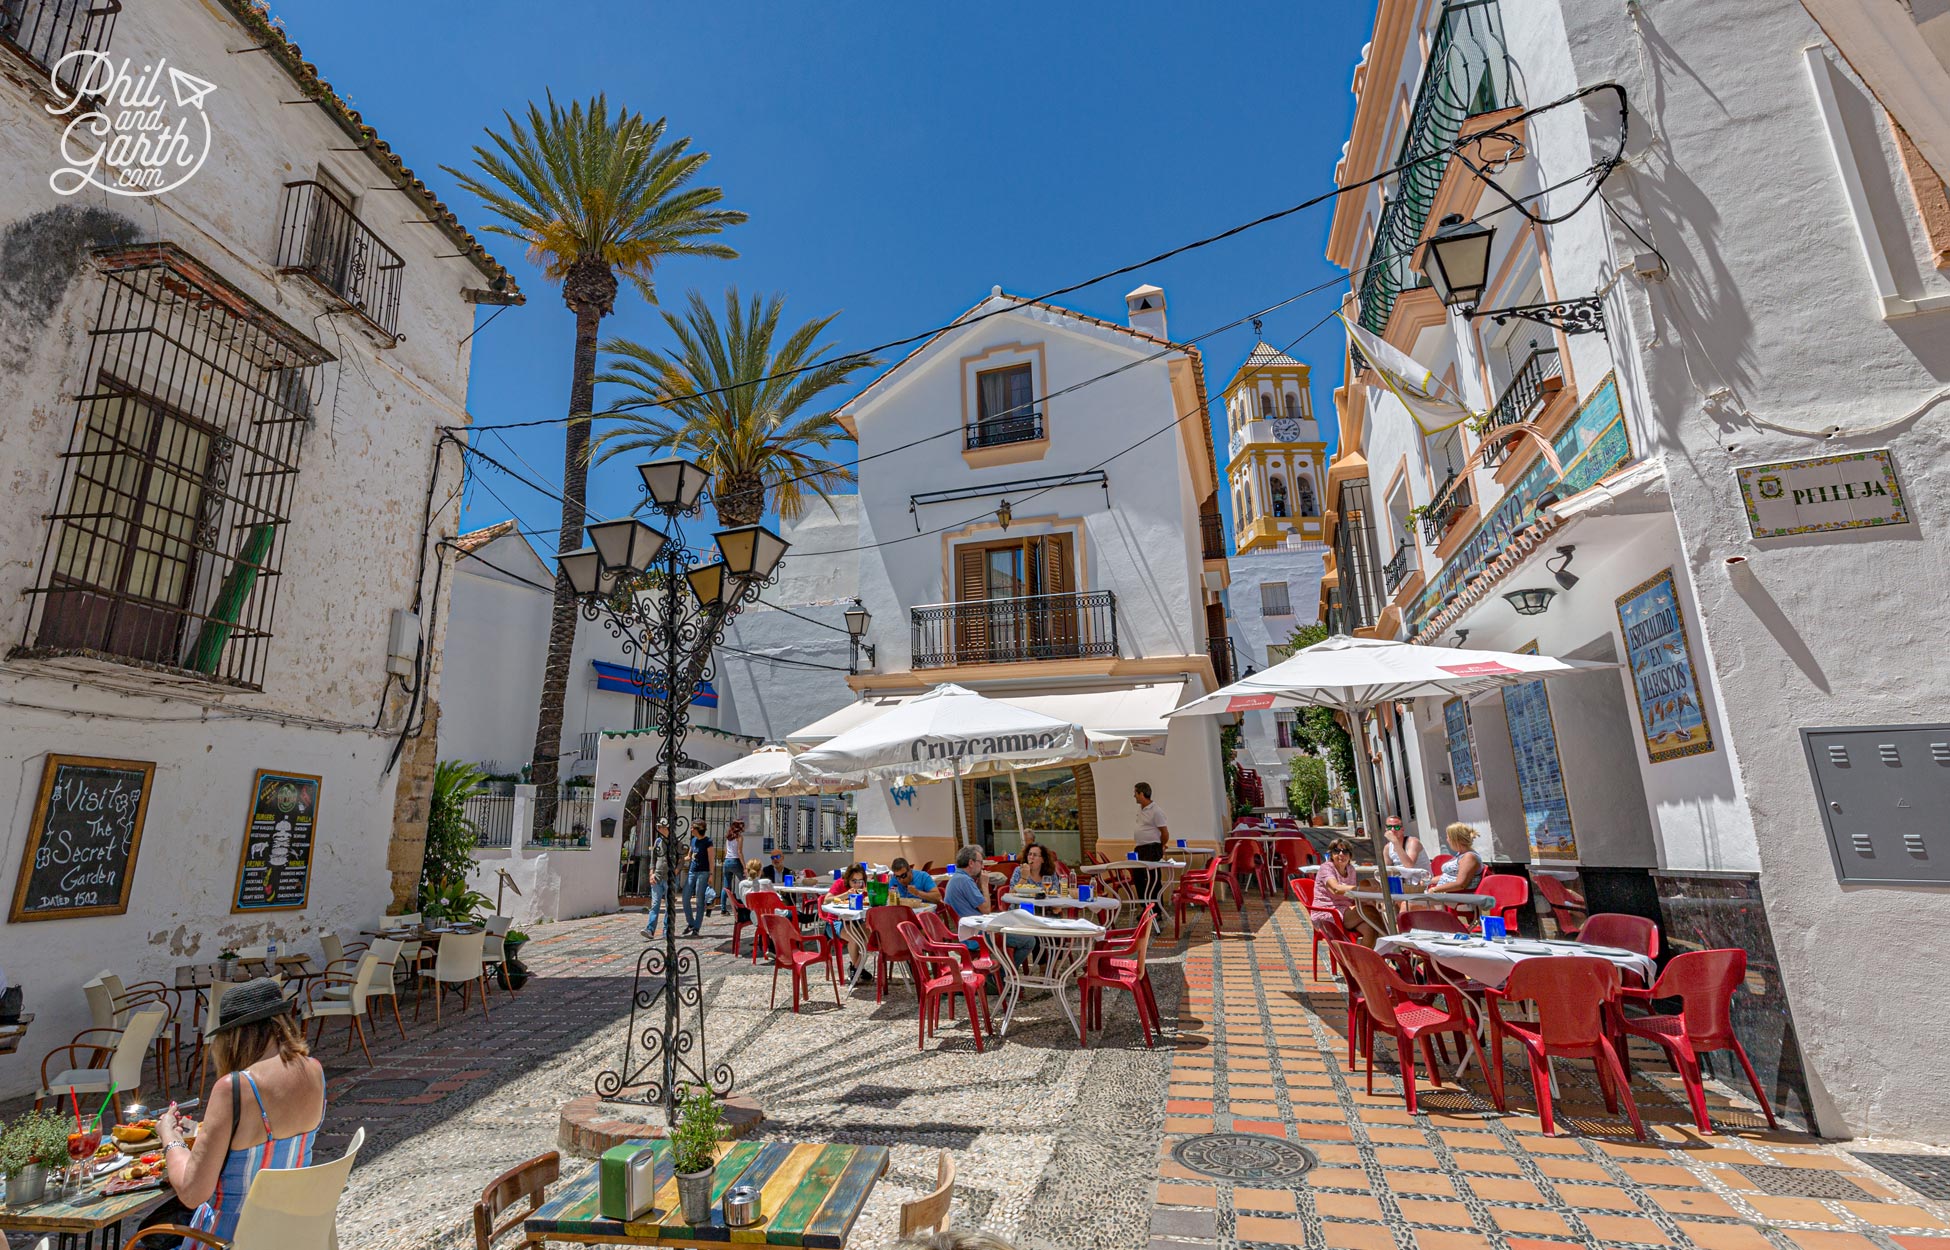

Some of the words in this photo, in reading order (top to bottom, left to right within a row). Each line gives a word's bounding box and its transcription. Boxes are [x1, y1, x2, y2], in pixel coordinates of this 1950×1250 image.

[1792, 480, 1888, 506] PELLEJA
[1628, 607, 1674, 650] ESPECIALIDAD
[1651, 646, 1662, 668] EN
[1640, 662, 1687, 701] MARISCOS
[910, 732, 1054, 762] Cruzcampo
[64, 778, 122, 812] Visit
[87, 816, 113, 837] The
[52, 830, 117, 864] Secret
[60, 864, 116, 891] Garden
[38, 894, 70, 908] DATED
[74, 891, 98, 906] 1502
